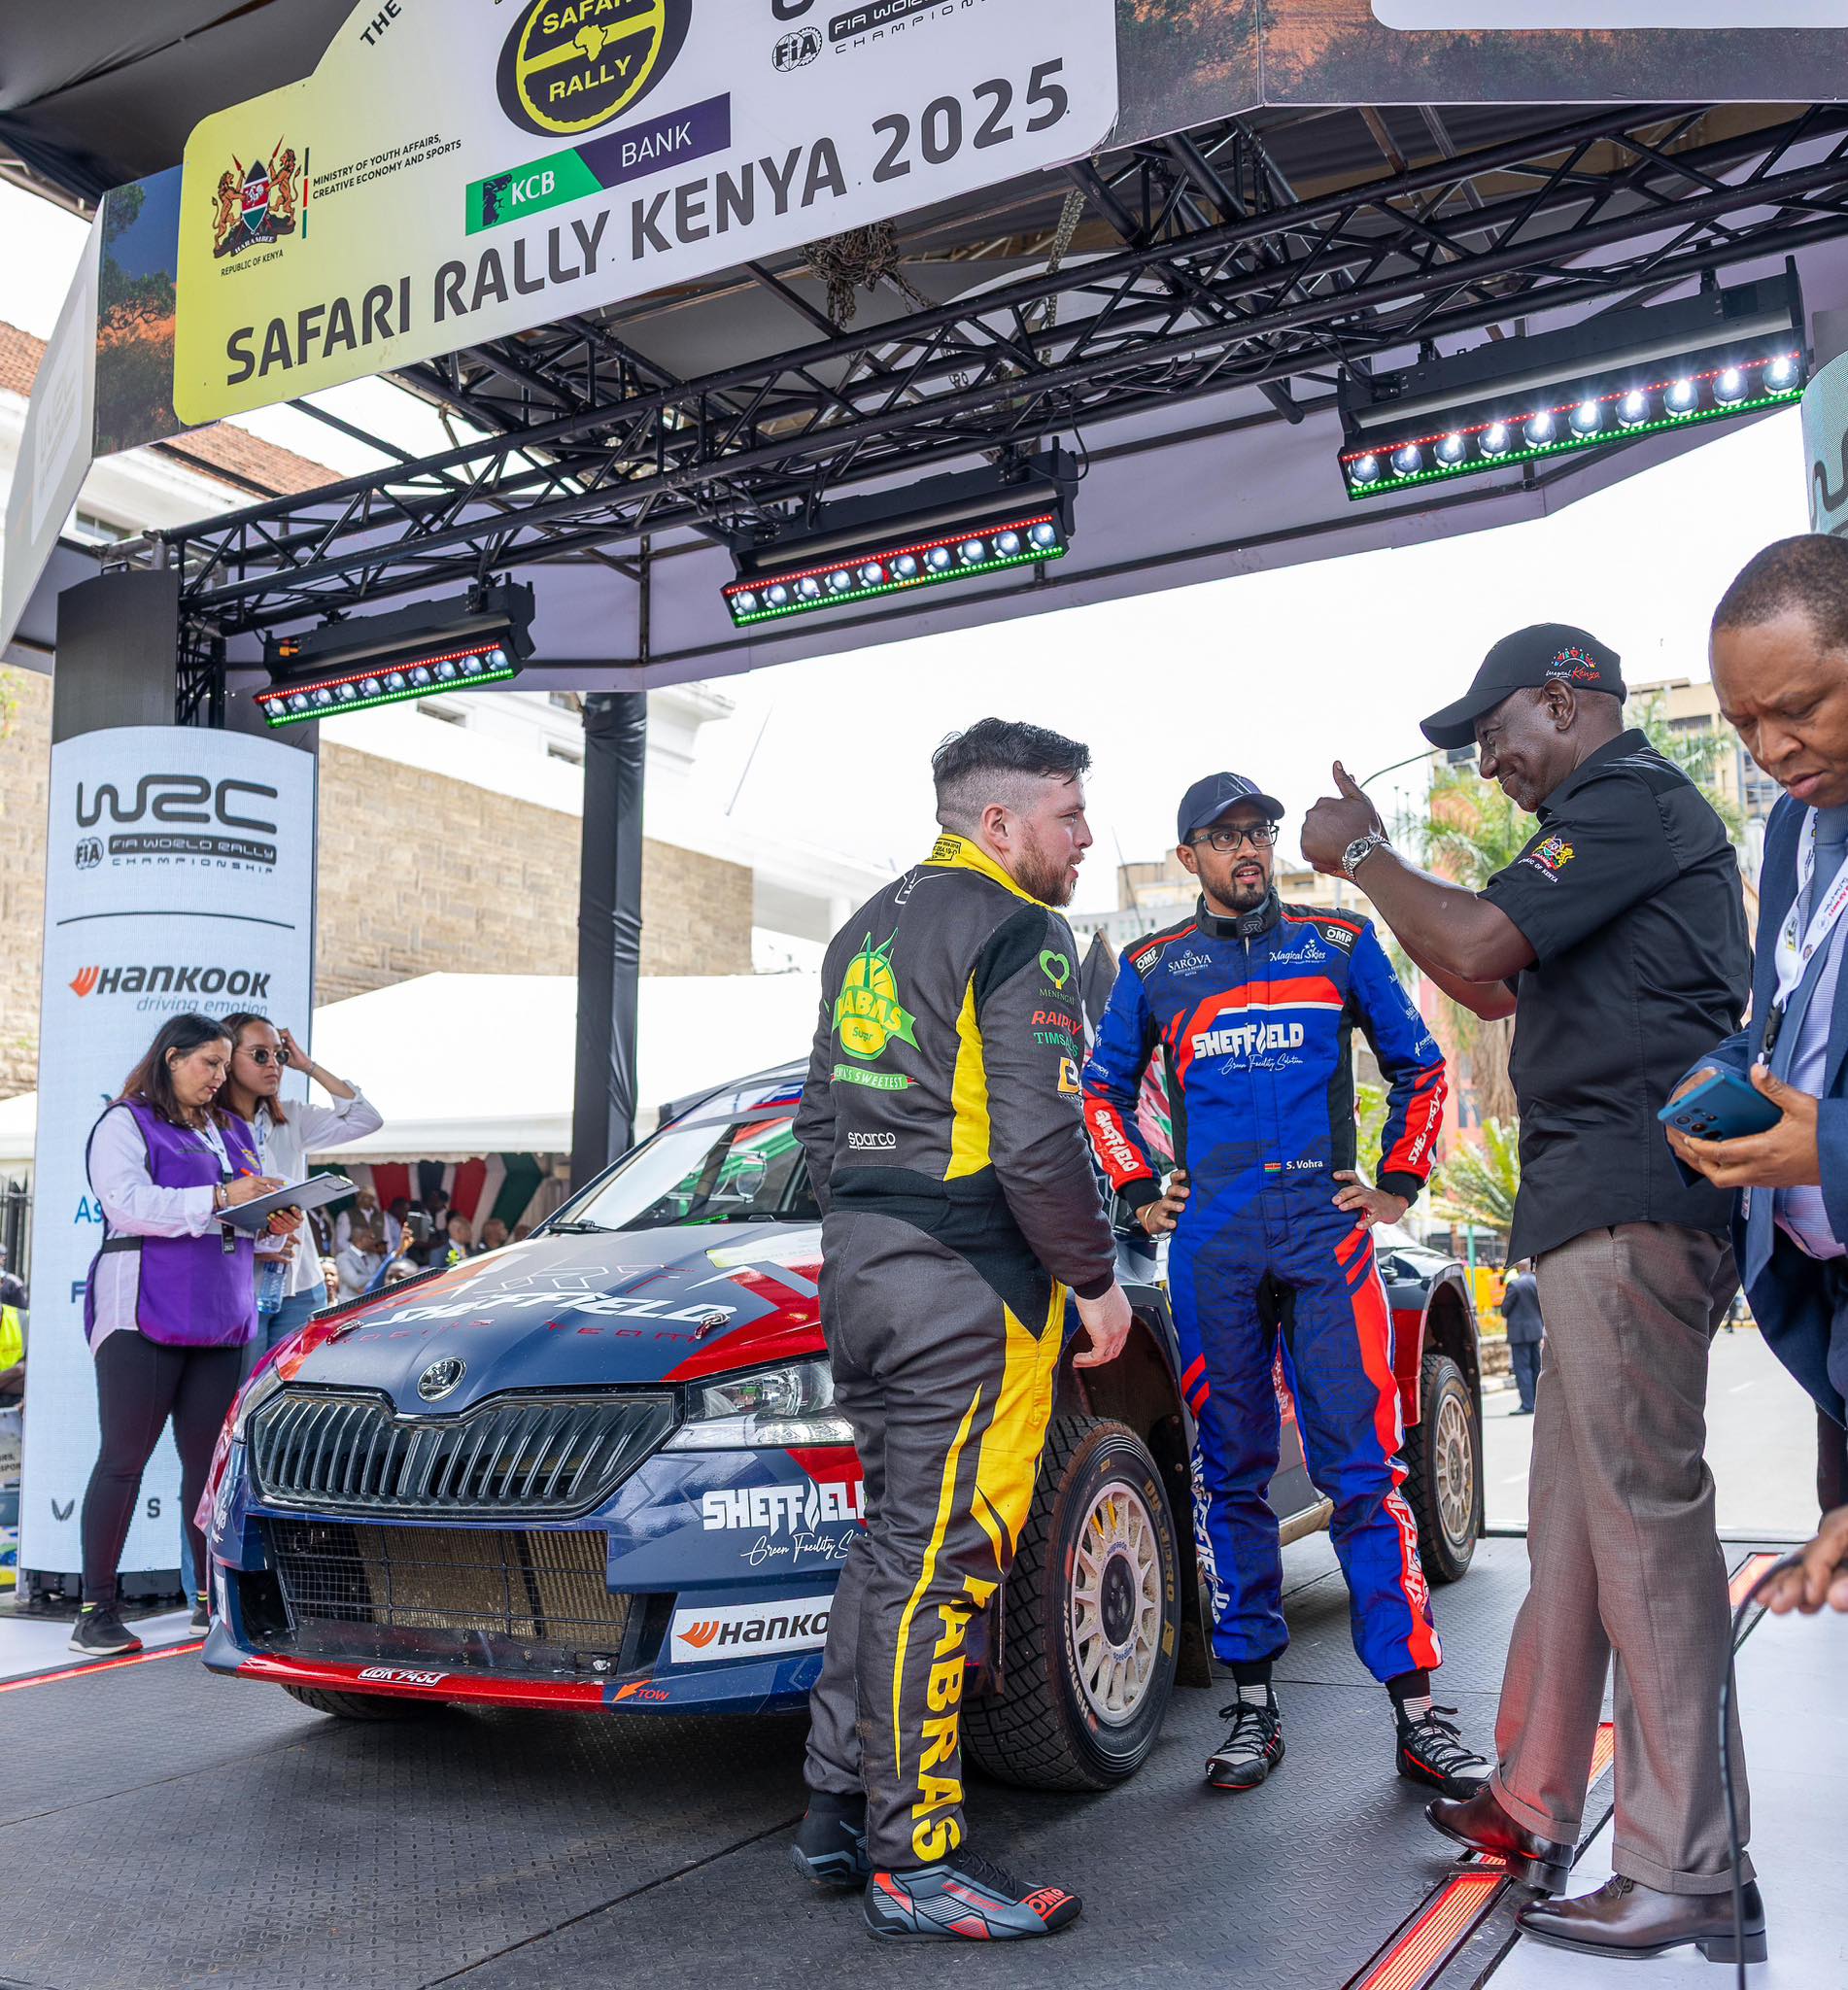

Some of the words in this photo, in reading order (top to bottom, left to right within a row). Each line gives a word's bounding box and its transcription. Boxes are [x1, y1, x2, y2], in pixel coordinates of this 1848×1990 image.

[359, 0, 402, 46] THE
[542, 0, 633, 35] SAFA
[835, 14, 867, 35] FIA
[836, 0, 985, 54] CHAMPION
[549, 54, 632, 102] RALLY
[312, 178, 355, 199] CREATIVE
[356, 159, 403, 185] ECONOMY
[404, 153, 425, 168] AND
[426, 139, 462, 159] SPORTS
[313, 164, 355, 187] MINISTRY
[356, 159, 368, 171] OF
[369, 148, 401, 166] YOUTH
[402, 134, 442, 154] AFFAIRS,
[511, 169, 555, 206] KCB
[622, 121, 692, 168] BANK
[226, 275, 411, 386] SAFARI
[434, 210, 610, 324] RALLY
[632, 136, 847, 259] KENYA
[872, 57, 1068, 184] 2025
[234, 235, 274, 254] HARAMBEE
[221, 259, 252, 277] REPUBLIC
[253, 257, 261, 266] OF
[262, 249, 284, 263] KENYA
[76, 773, 278, 835] WRC
[112, 840, 138, 850] FIA
[143, 837, 212, 851] WORLD
[218, 841, 274, 860] RALLY
[112, 856, 273, 875] CHAMPIONSHIP
[1541, 869, 1559, 883] KENYA
[1327, 928, 1352, 944] OMP
[1137, 948, 1157, 970] OMP
[1168, 953, 1213, 972] SAROVA
[1269, 949, 1303, 965] Magical
[1304, 947, 1326, 960] Skies
[136, 996, 197, 1012] driving
[203, 1000, 267, 1016] emotion
[1191, 1020, 1304, 1060] SHEFFIELD
[1218, 1057, 1247, 1076] Green
[855, 1071, 903, 1088] SWEETEST
[847, 1131, 896, 1150] sparco
[1286, 1161, 1295, 1170] S.
[1296, 1159, 1323, 1169] Vohra
[544, 1319, 697, 1344] TEAM
[740, 1534, 790, 1566] Green
[792, 1529, 837, 1563] Facility
[636, 1688, 670, 1701] TOW
[1028, 1888, 1066, 1915] OMP
